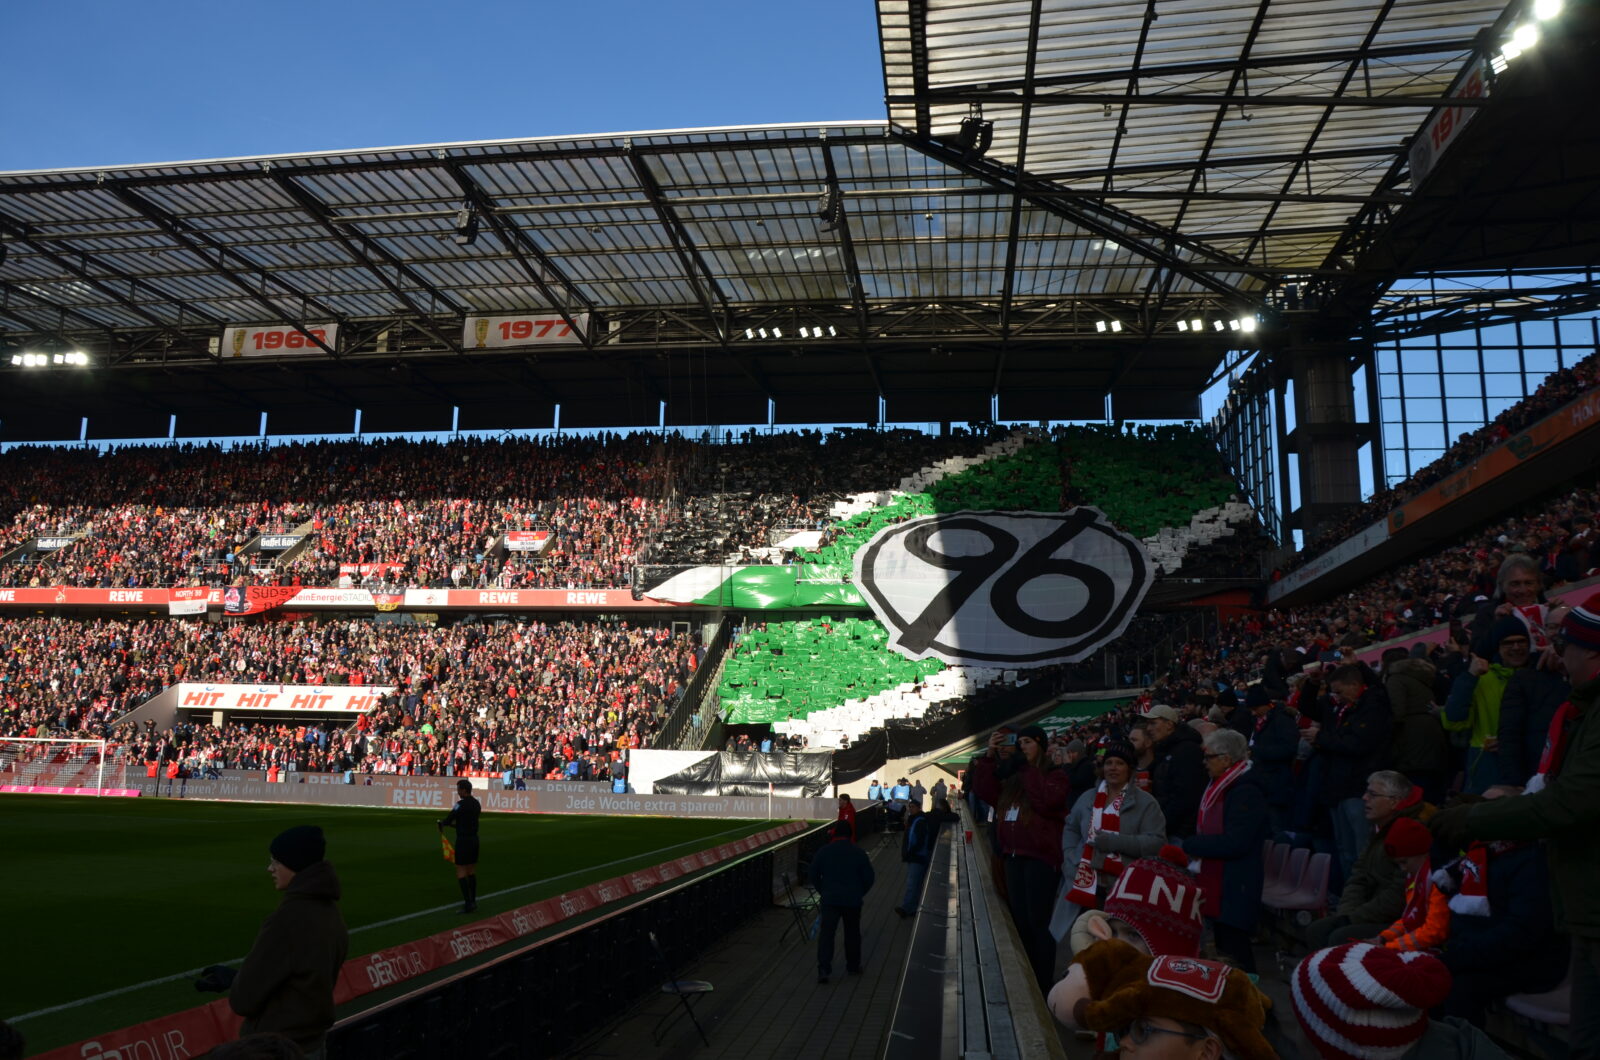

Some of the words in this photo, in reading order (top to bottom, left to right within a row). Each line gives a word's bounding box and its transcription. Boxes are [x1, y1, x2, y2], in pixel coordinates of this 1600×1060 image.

[498, 319, 577, 340] 1977
[896, 507, 1099, 655] 96
[109, 590, 143, 602] REWE
[479, 591, 519, 604] REWE
[566, 592, 608, 605] REWE
[183, 691, 225, 706] HIT
[236, 692, 279, 708] HIT
[290, 694, 334, 709] HIT
[393, 789, 443, 806] REWE
[486, 793, 530, 809] Markt
[566, 795, 595, 809] Jede
[599, 797, 640, 812] Woche
[644, 799, 676, 812] extra
[680, 800, 729, 816] sparen?
[732, 800, 755, 813] Mit
[760, 801, 782, 813] dn
[450, 928, 496, 959] DERTOUR
[366, 951, 425, 988] DERTOUR
